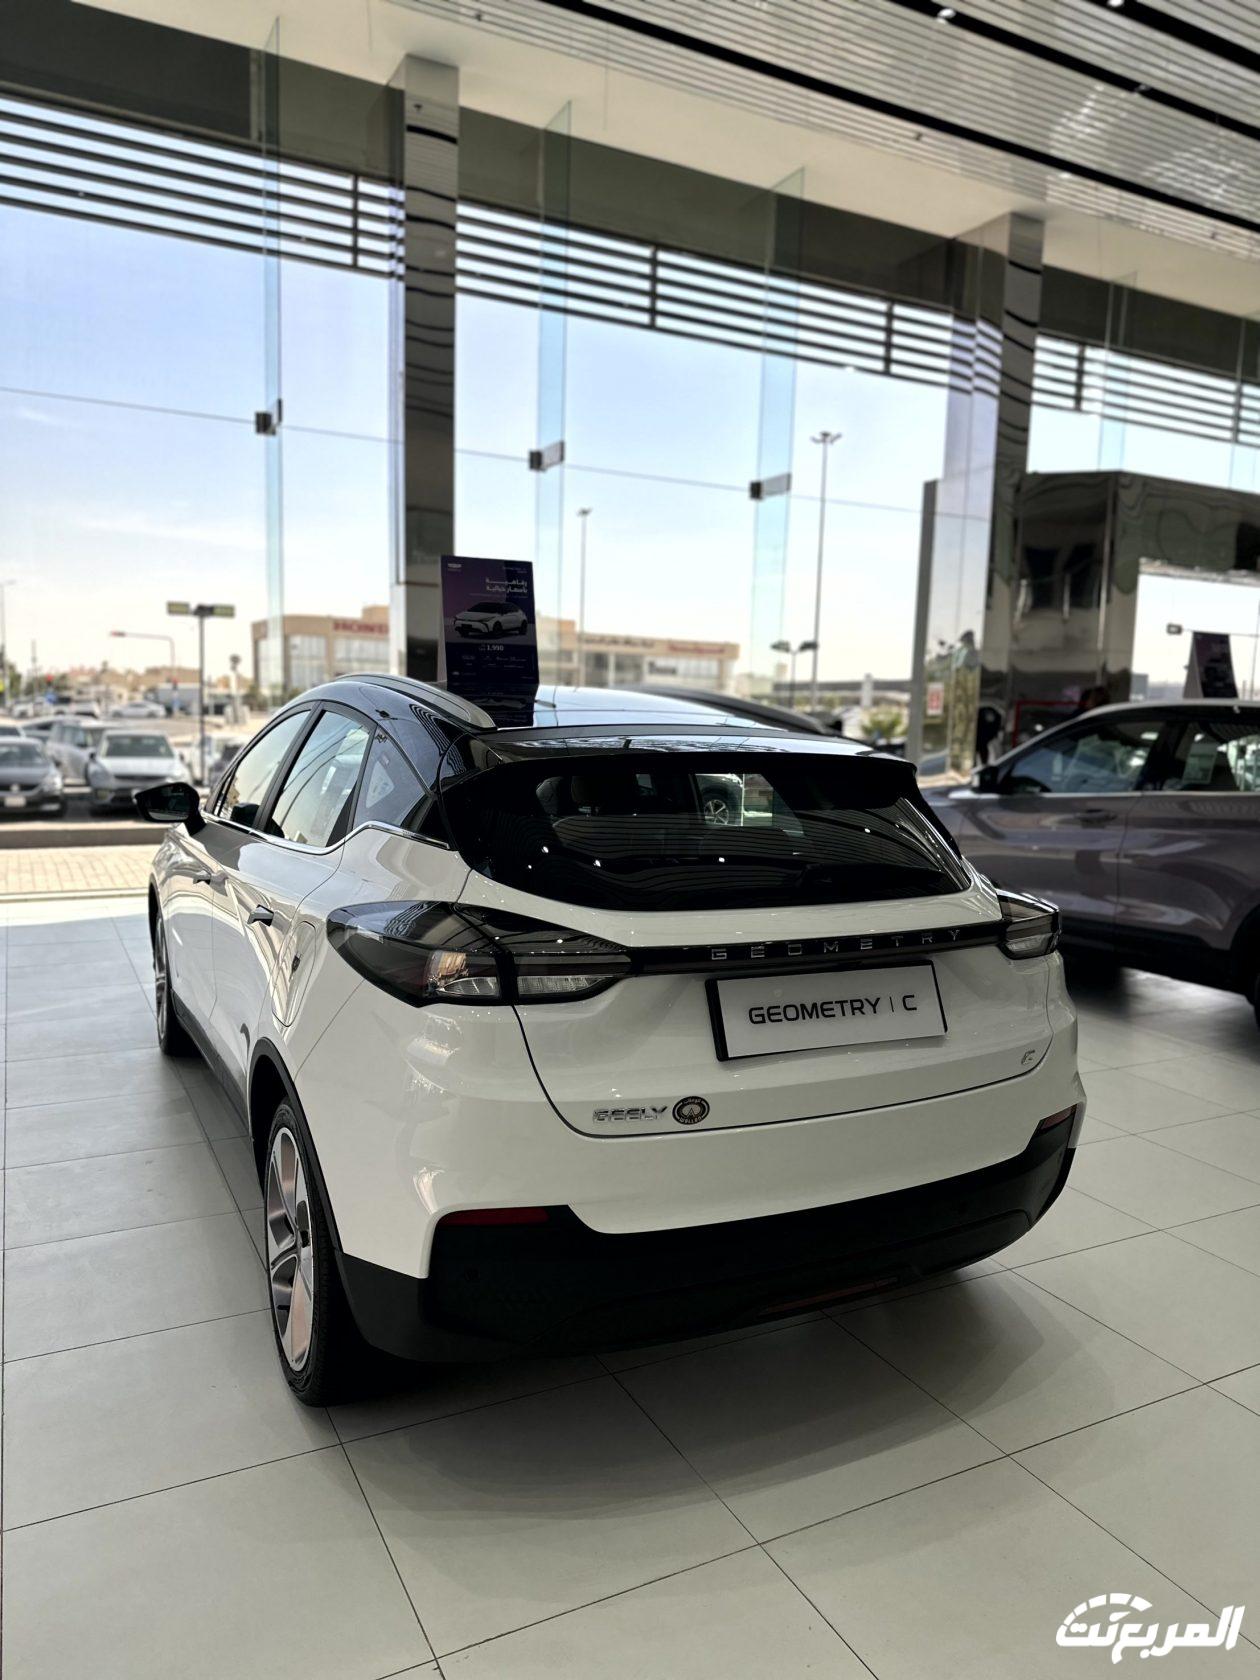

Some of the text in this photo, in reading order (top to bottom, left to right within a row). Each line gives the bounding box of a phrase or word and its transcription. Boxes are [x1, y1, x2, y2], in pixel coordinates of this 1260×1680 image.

[711, 929, 960, 961] GEOMETRY
[748, 997, 880, 1025] GEOMETRY
[902, 994, 918, 1012] C
[593, 1105, 667, 1122] GEELY
